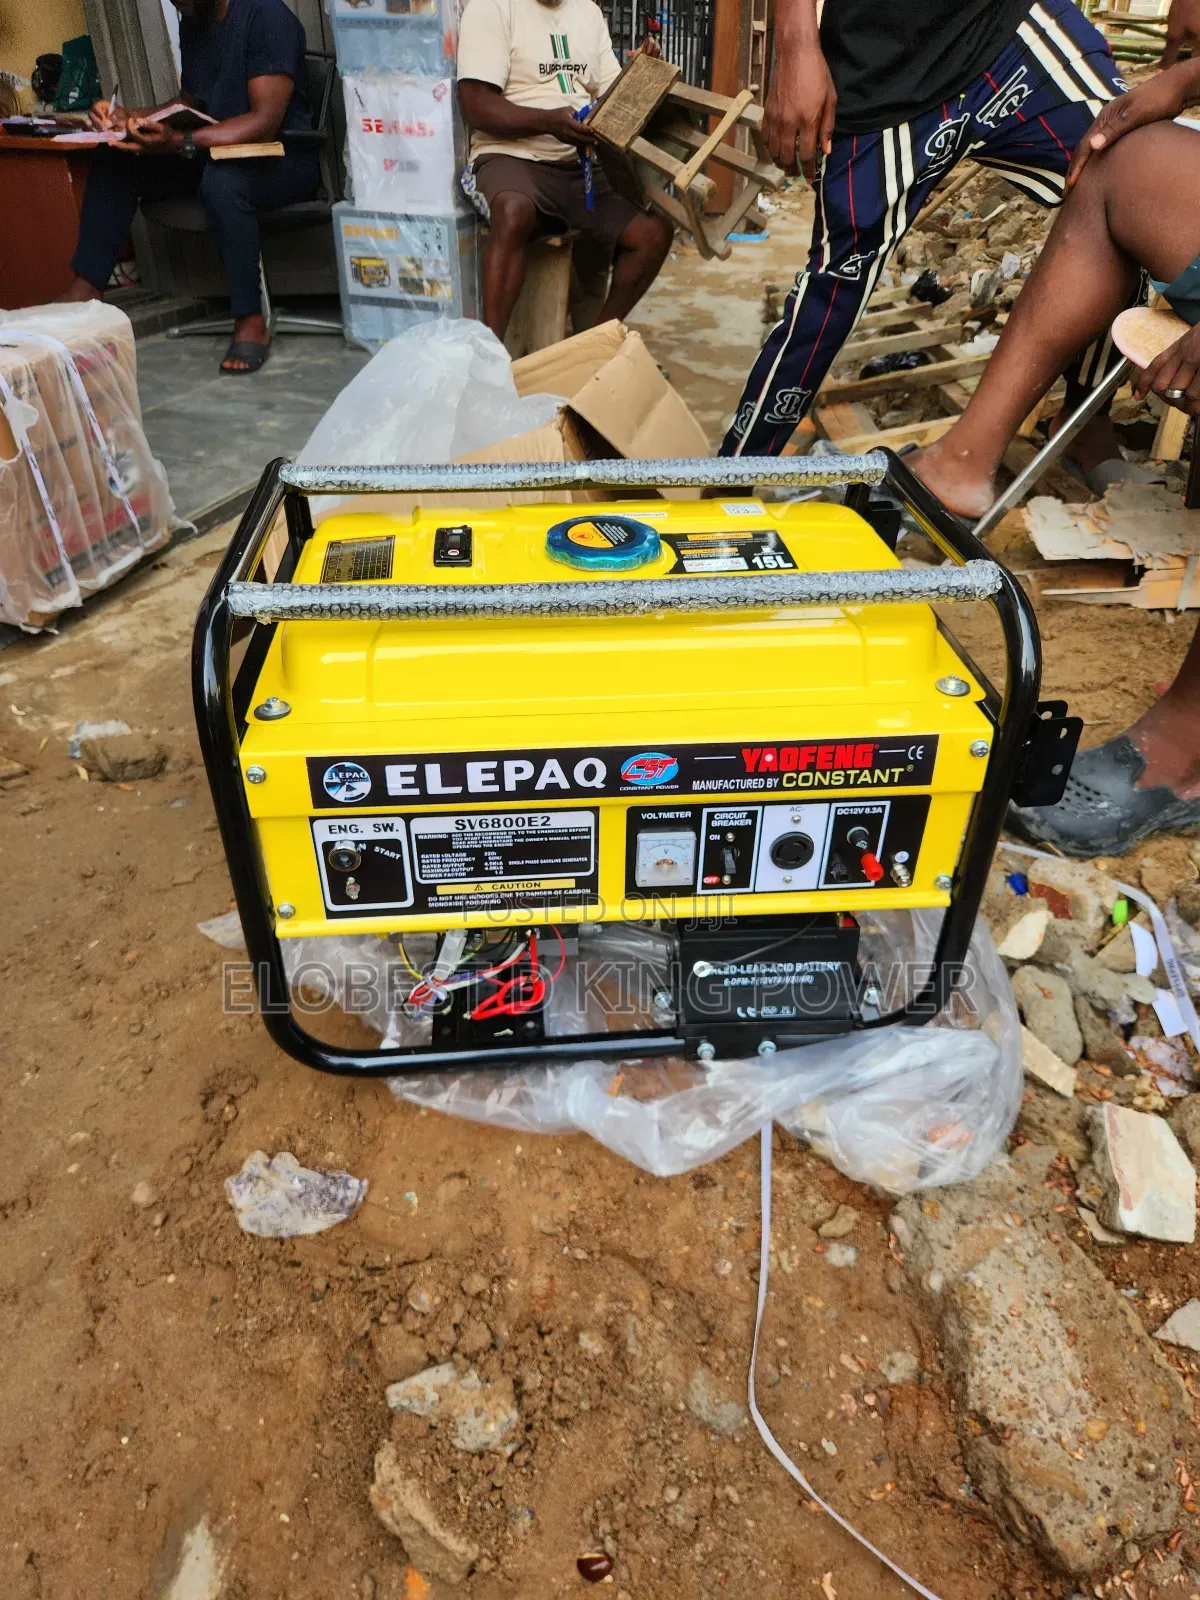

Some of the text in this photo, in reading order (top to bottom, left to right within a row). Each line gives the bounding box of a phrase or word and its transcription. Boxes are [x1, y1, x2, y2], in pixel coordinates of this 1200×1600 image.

[752, 555, 794, 570] 15L
[385, 757, 608, 796] ELEPAQ
[692, 778, 765, 791] MANUFACTURED
[766, 777, 780, 789] BY
[640, 811, 692, 820] VOLTMETER
[714, 812, 748, 820] CIRCUIT
[328, 822, 400, 835] ENG. SW.
[454, 816, 551, 831] SV6800E2
[711, 819, 752, 827] BREAKER
[373, 845, 402, 860] START
[491, 882, 541, 890] CAUTION
[795, 961, 841, 973] BATTERY
